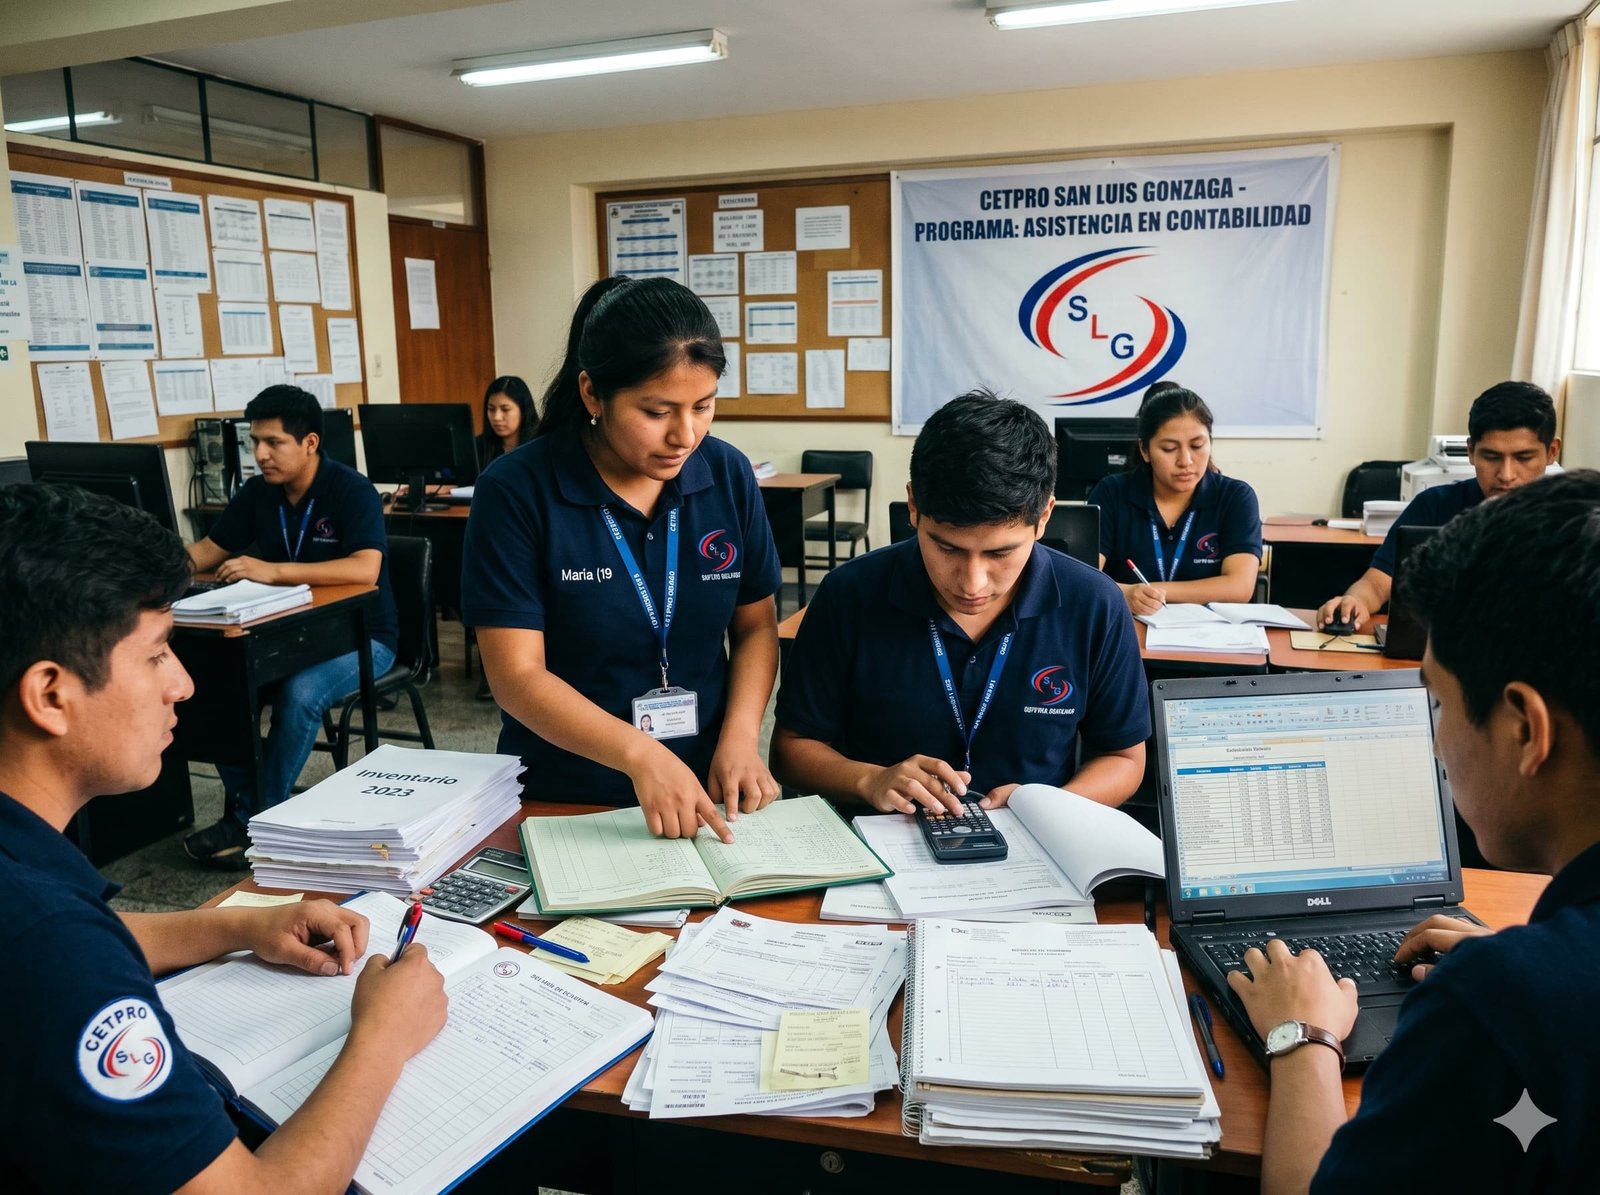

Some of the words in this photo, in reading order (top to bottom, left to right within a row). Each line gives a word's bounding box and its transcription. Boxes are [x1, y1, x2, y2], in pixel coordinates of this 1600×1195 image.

[979, 186, 1050, 212] CETPRO
[1053, 184, 1092, 208] SAN
[1096, 182, 1138, 206] LUIS
[1142, 177, 1234, 203] GONZAGA
[914, 218, 1020, 243] PROGRAMA:
[1022, 211, 1134, 238] ASISTENCIA
[1138, 211, 1161, 233] EN
[1166, 203, 1312, 232] CONTABILIDAD
[596, 567, 613, 583] (19
[356, 769, 458, 785] Inventario
[361, 785, 415, 797] 2023
[1306, 896, 1332, 907] DELL
[85, 1006, 147, 1051] CETPRO
[115, 1051, 155, 1065] SLG
